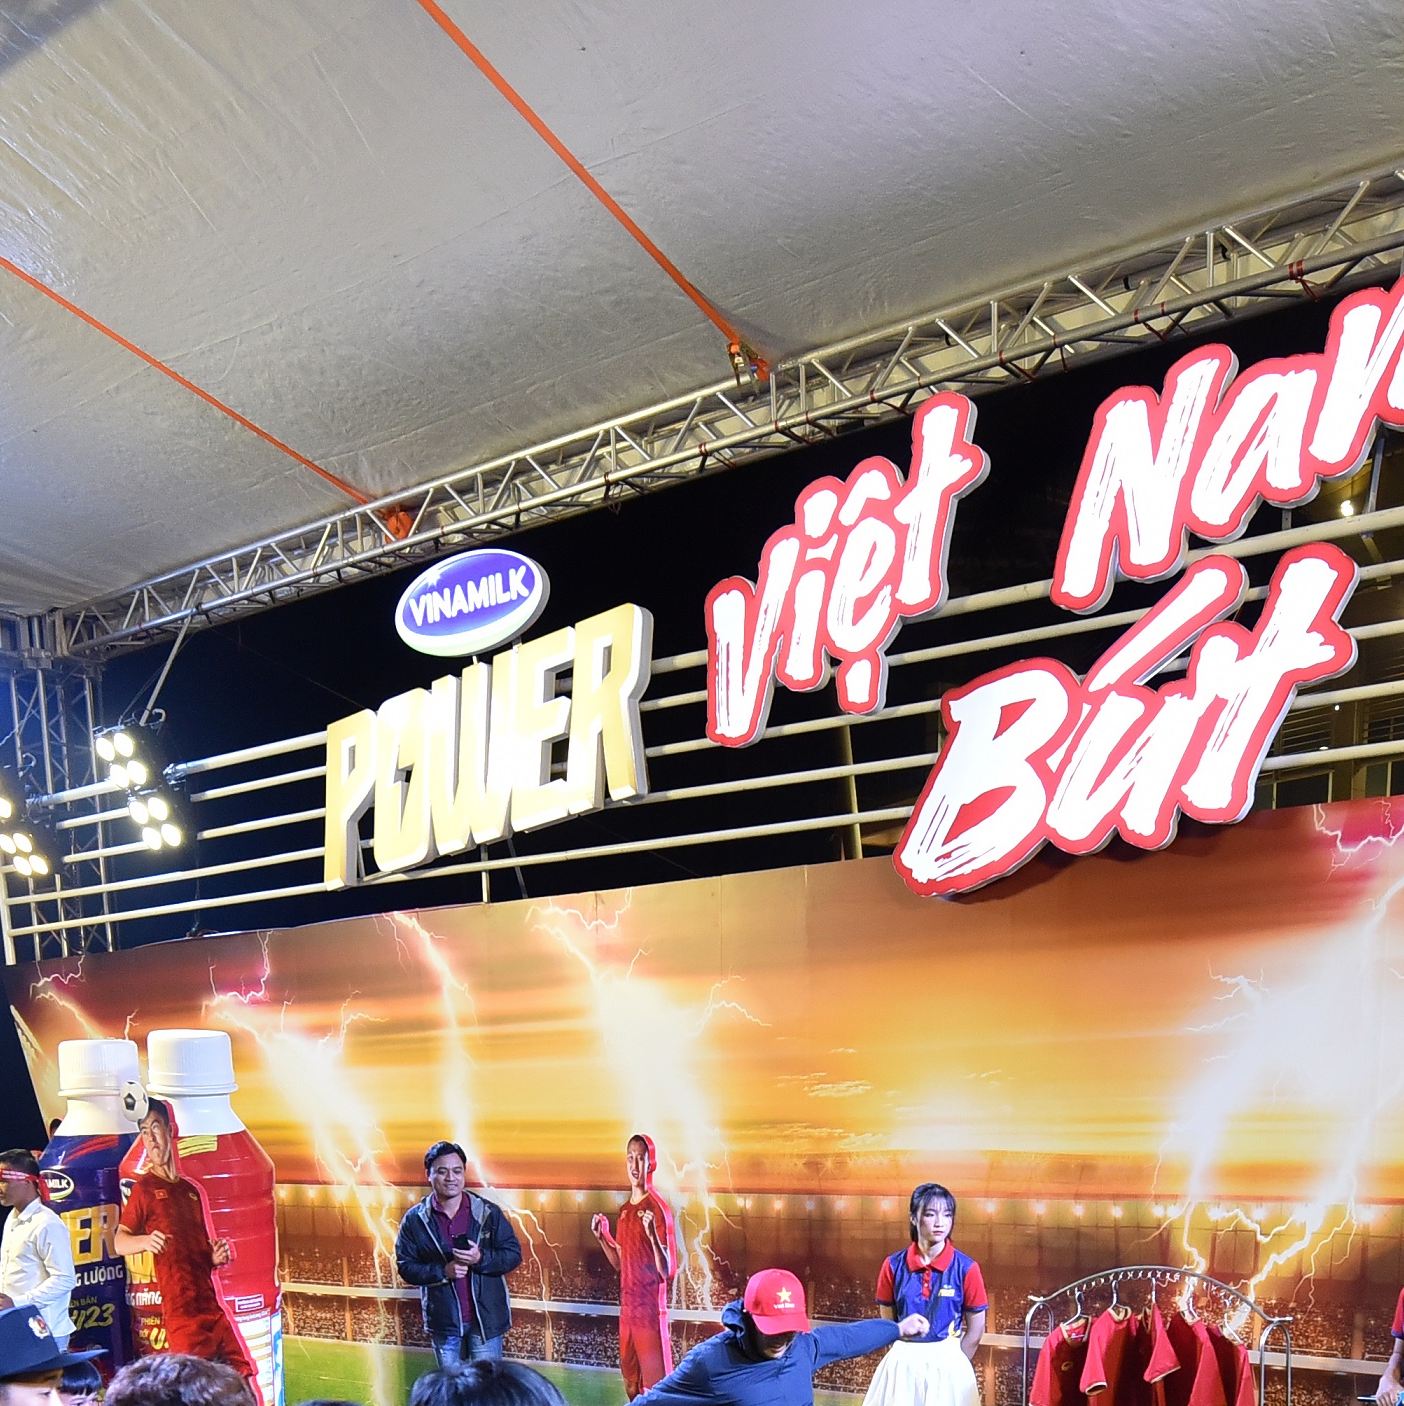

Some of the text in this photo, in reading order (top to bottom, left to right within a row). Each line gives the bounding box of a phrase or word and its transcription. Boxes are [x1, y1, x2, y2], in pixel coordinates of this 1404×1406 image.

[408, 563, 532, 628] VINAMILK
[708, 395, 984, 745] Việt
[325, 602, 653, 891] POWER
[83, 1264, 124, 1286] LƯỢNG
